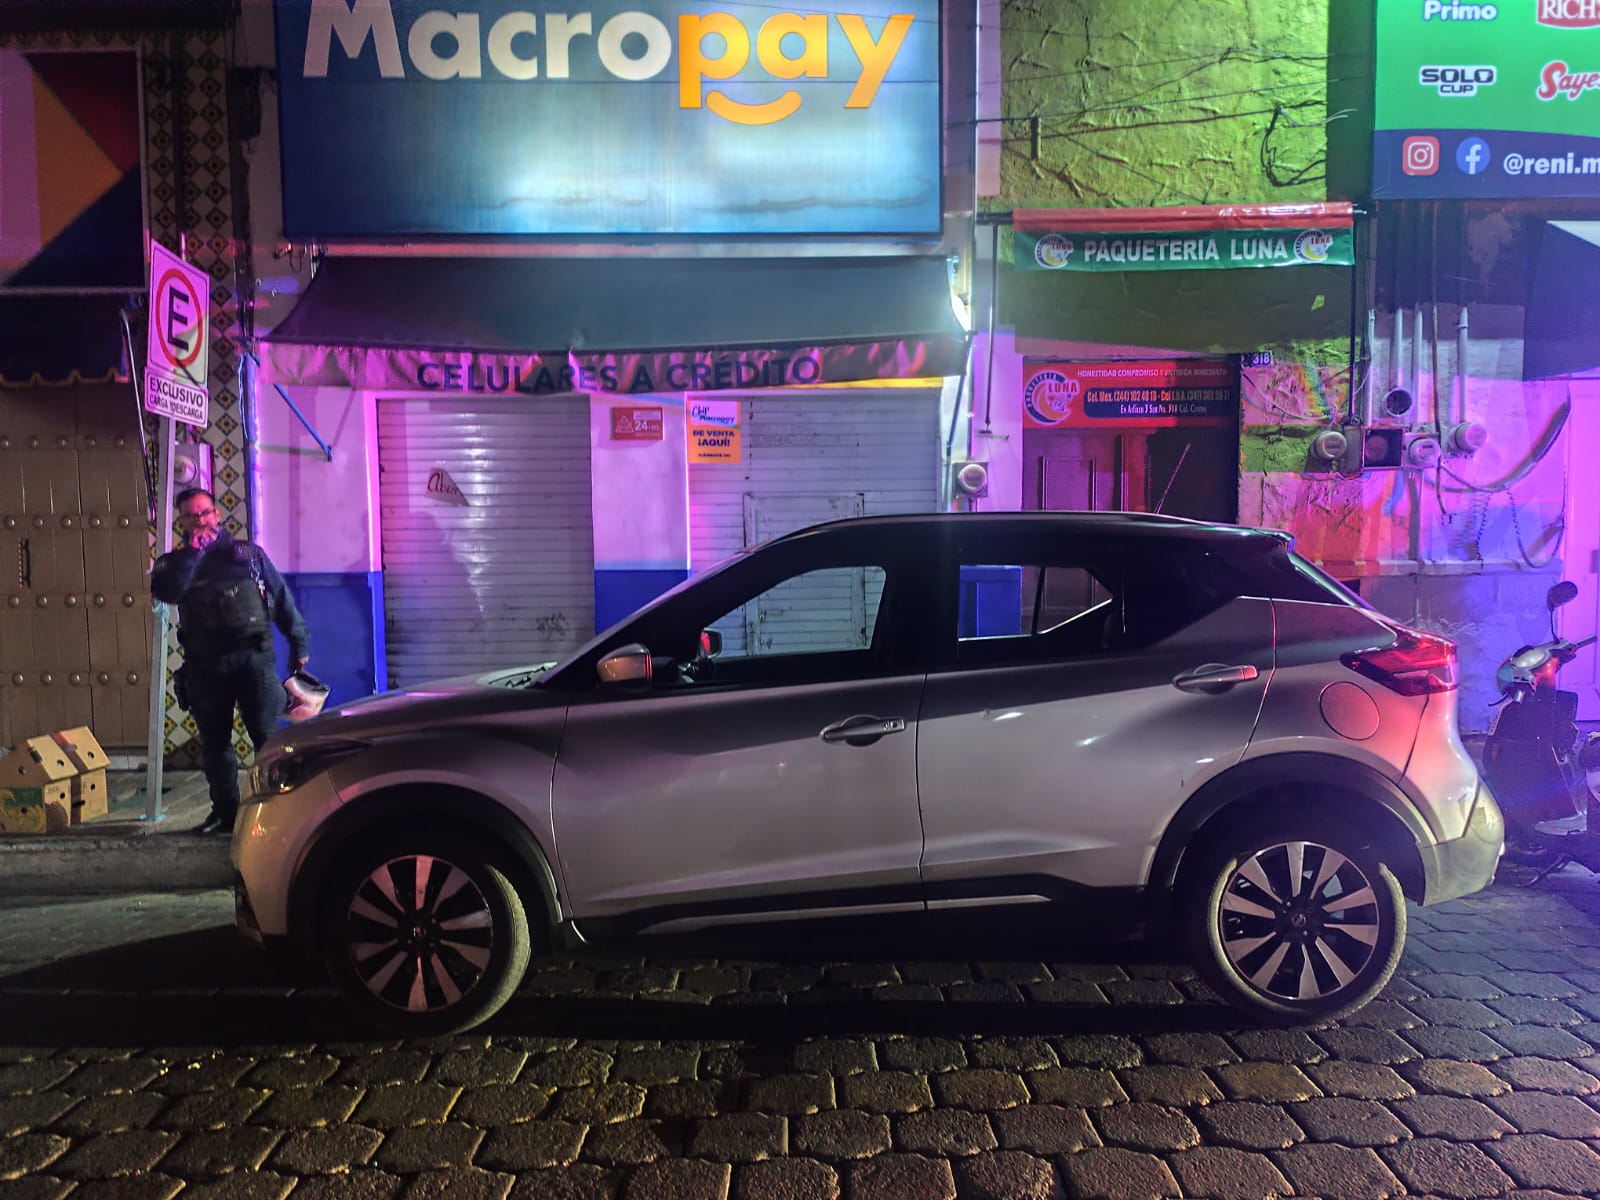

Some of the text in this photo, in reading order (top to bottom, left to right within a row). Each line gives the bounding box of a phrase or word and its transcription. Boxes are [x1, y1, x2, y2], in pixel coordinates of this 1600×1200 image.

[1423, 0, 1499, 21] Primo
[1540, 0, 1600, 19] RICH
[303, 0, 915, 109] Macropay
[1421, 68, 1494, 84] SOLO
[1440, 84, 1474, 94] CUP
[1083, 239, 1288, 263] PAQUETERIA LUNA
[168, 286, 189, 352] E
[1253, 352, 1270, 365] 318
[416, 355, 820, 394] CELULARES A CRÉDITO
[1077, 369, 1117, 377] HONESTIDAD
[1118, 368, 1159, 376] COMPROMISO
[150, 376, 203, 408] EXCLUSIVO
[1049, 383, 1078, 392] LUNA
[634, 420, 648, 432] 24
